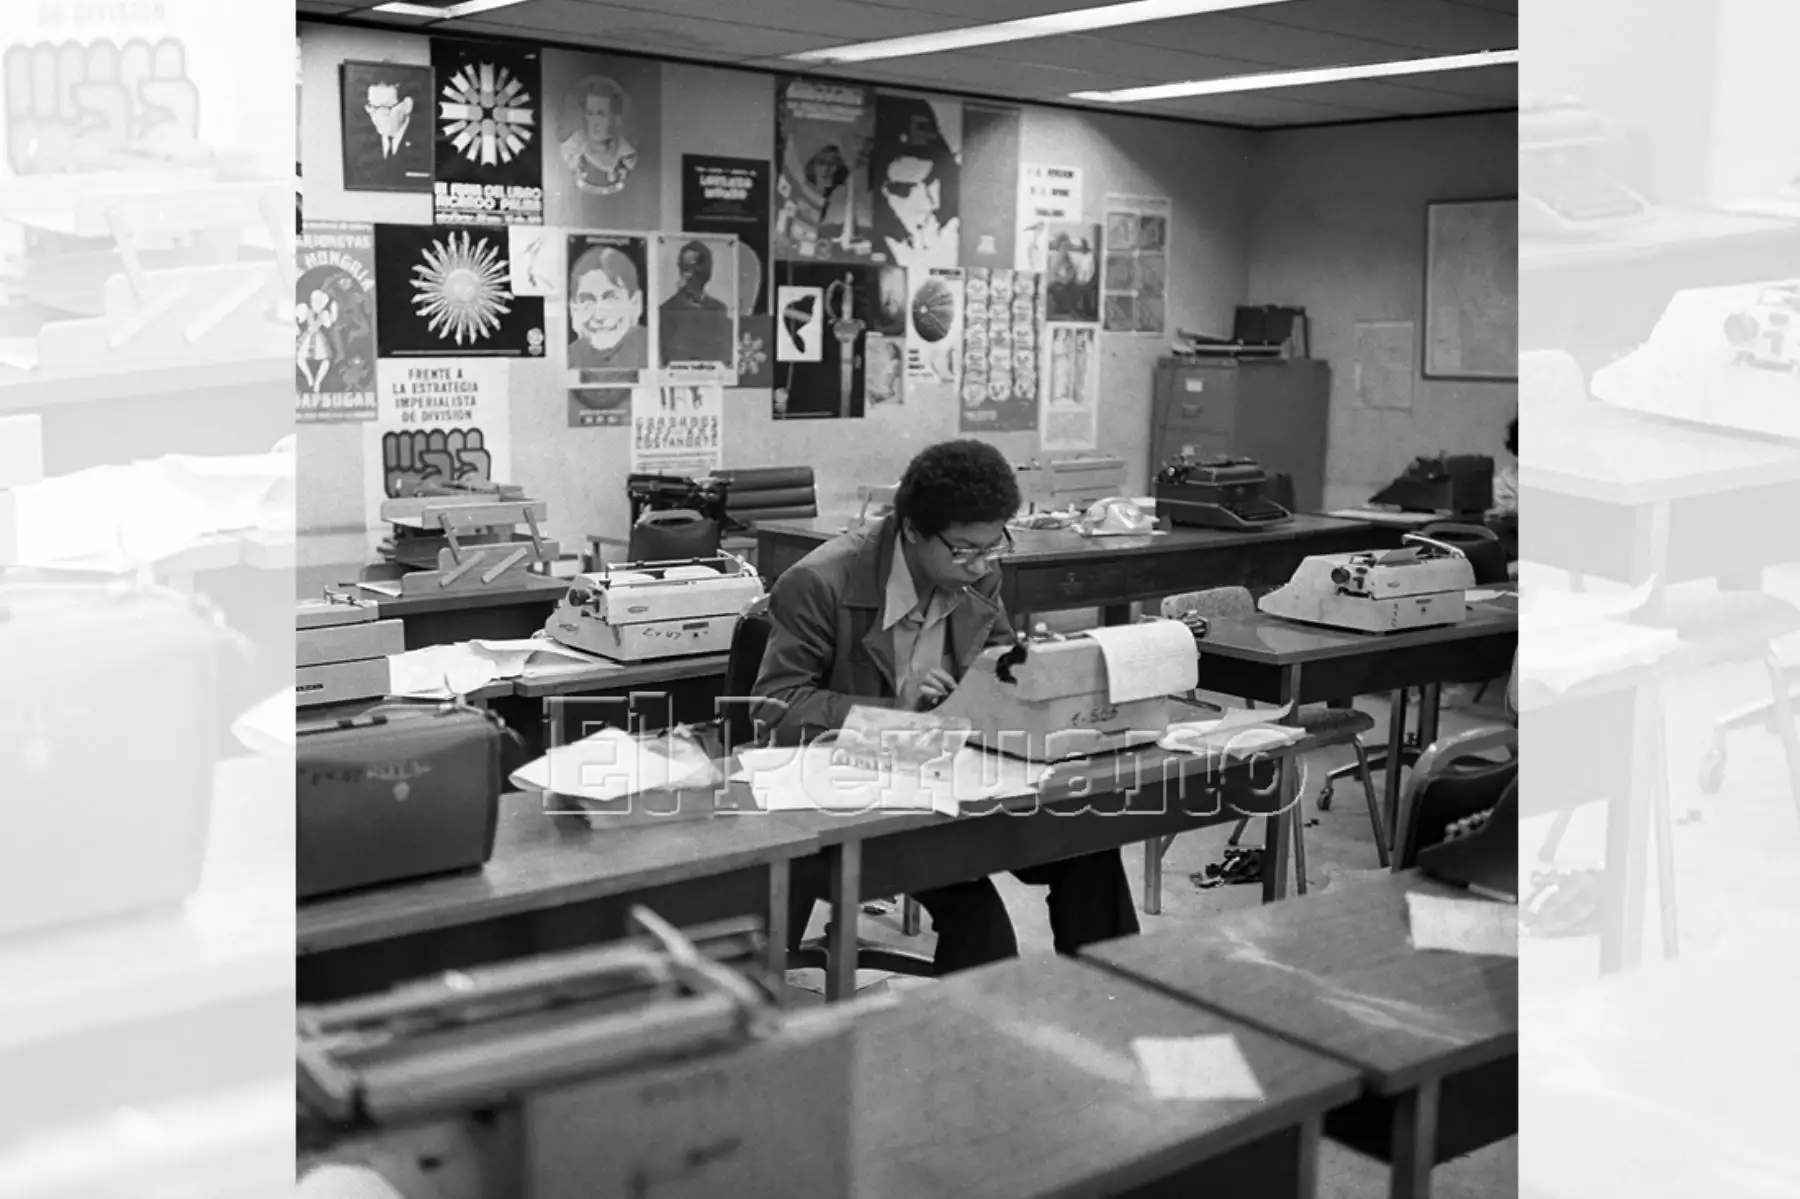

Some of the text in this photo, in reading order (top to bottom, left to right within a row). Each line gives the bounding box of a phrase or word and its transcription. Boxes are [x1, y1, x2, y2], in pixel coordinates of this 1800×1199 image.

[296, 234, 371, 249] ARIONETAS
[408, 367, 463, 380] FRENTE A
[392, 381, 478, 394] LA ESTRATEGIA
[395, 395, 476, 408] IMPERIALISTA
[401, 410, 473, 422] DE DIVISION
